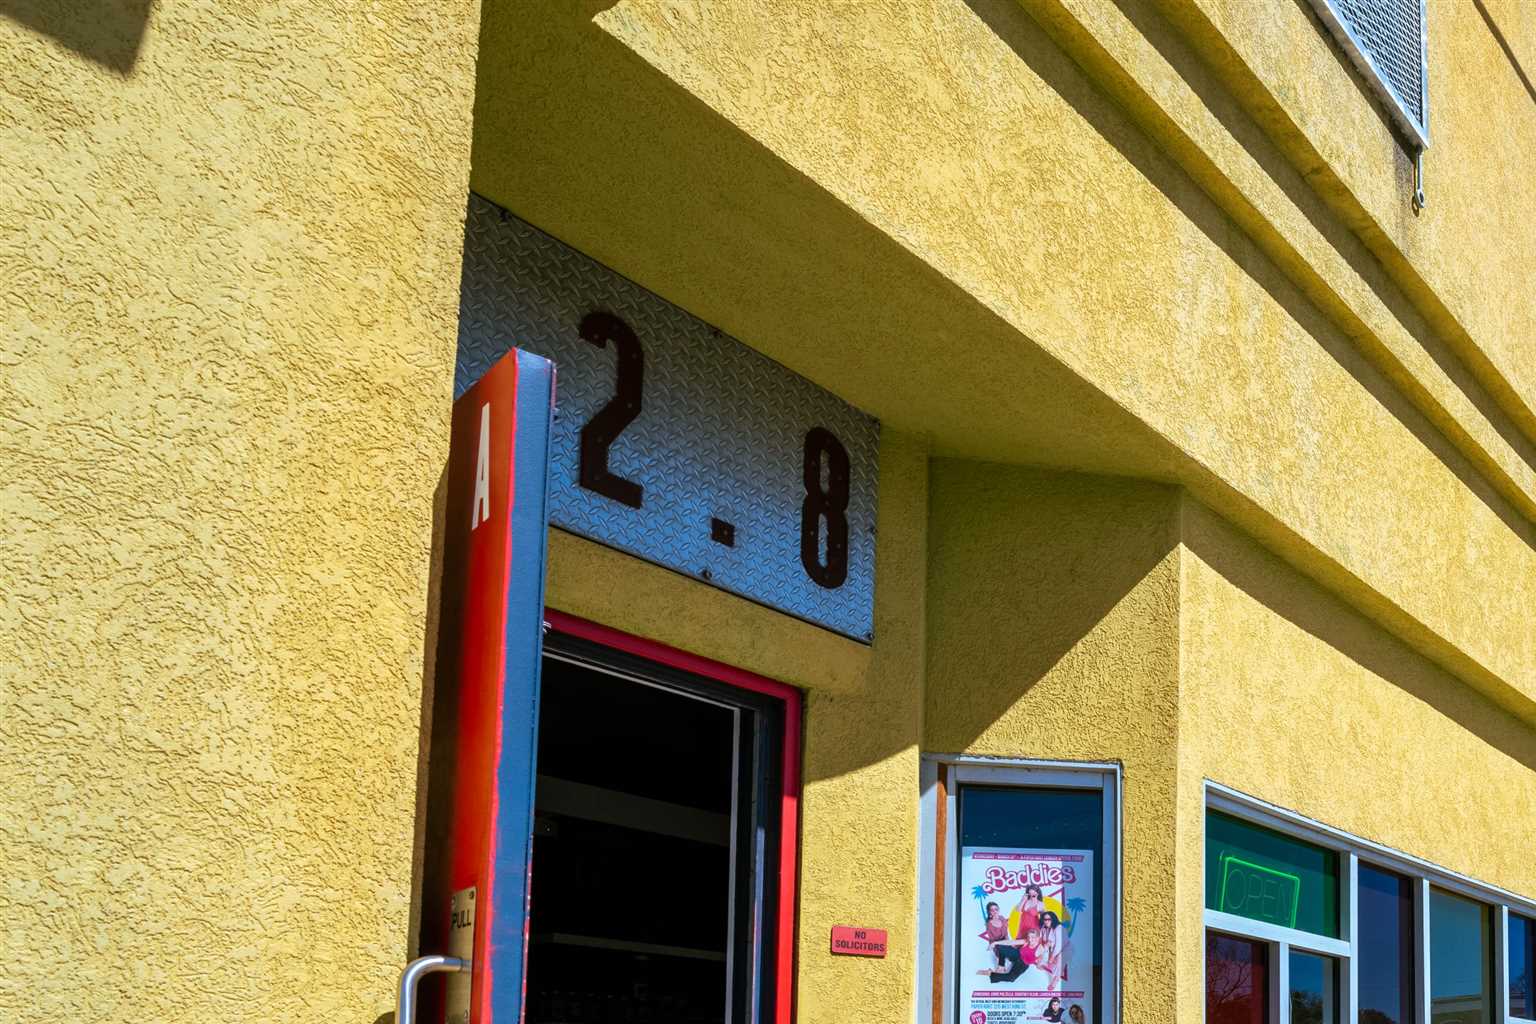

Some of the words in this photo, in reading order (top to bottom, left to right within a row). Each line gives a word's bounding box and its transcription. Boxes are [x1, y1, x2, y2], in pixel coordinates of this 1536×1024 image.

[982, 863, 1077, 894] Baddies
[452, 909, 472, 929] PULL
[854, 931, 866, 940] NO
[835, 939, 885, 952] SOLICITORS
